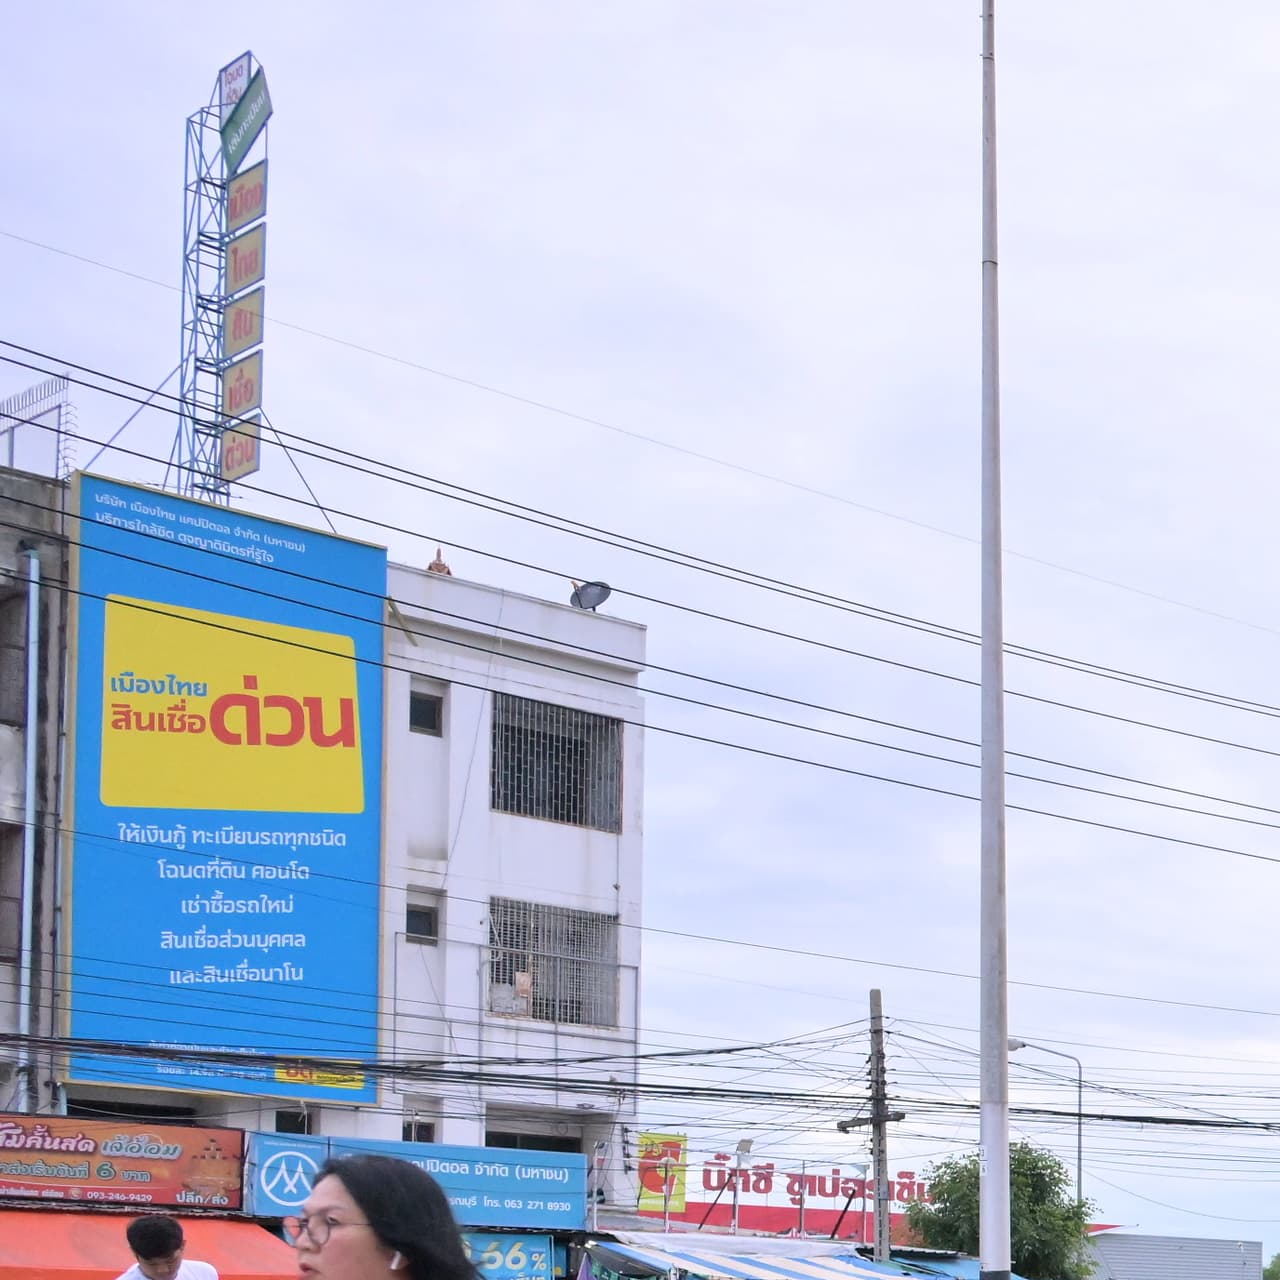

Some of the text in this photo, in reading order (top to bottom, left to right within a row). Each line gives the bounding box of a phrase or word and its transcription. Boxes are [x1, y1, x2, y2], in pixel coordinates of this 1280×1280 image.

[131, 501, 176, 521] เมืองไทย
[234, 527, 261, 543] จำกัด
[264, 533, 305, 553] (มหาชน)
[111, 671, 208, 696] เมืองไทย
[111, 674, 356, 748] สินเชื่อ ด่วน
[117, 823, 347, 852] ให้เงินกู้ ทะเบียนรถทุกชนิด
[157, 856, 310, 880] โฉนดที่ดิน คอนโด
[181, 890, 294, 914] เช่าซื้อรถใหม่
[160, 925, 307, 952] สินเชื่อส่วนบุคคล
[169, 959, 304, 984] และสินเชื่อนาโน
[96, 1161, 117, 1181] 6
[475, 1162, 508, 1177] จำกัด
[515, 1165, 569, 1184] (มหาชน)
[703, 1153, 775, 1193] บิ๊กซี
[505, 1200, 522, 1208] 063
[527, 1201, 543, 1210] 271
